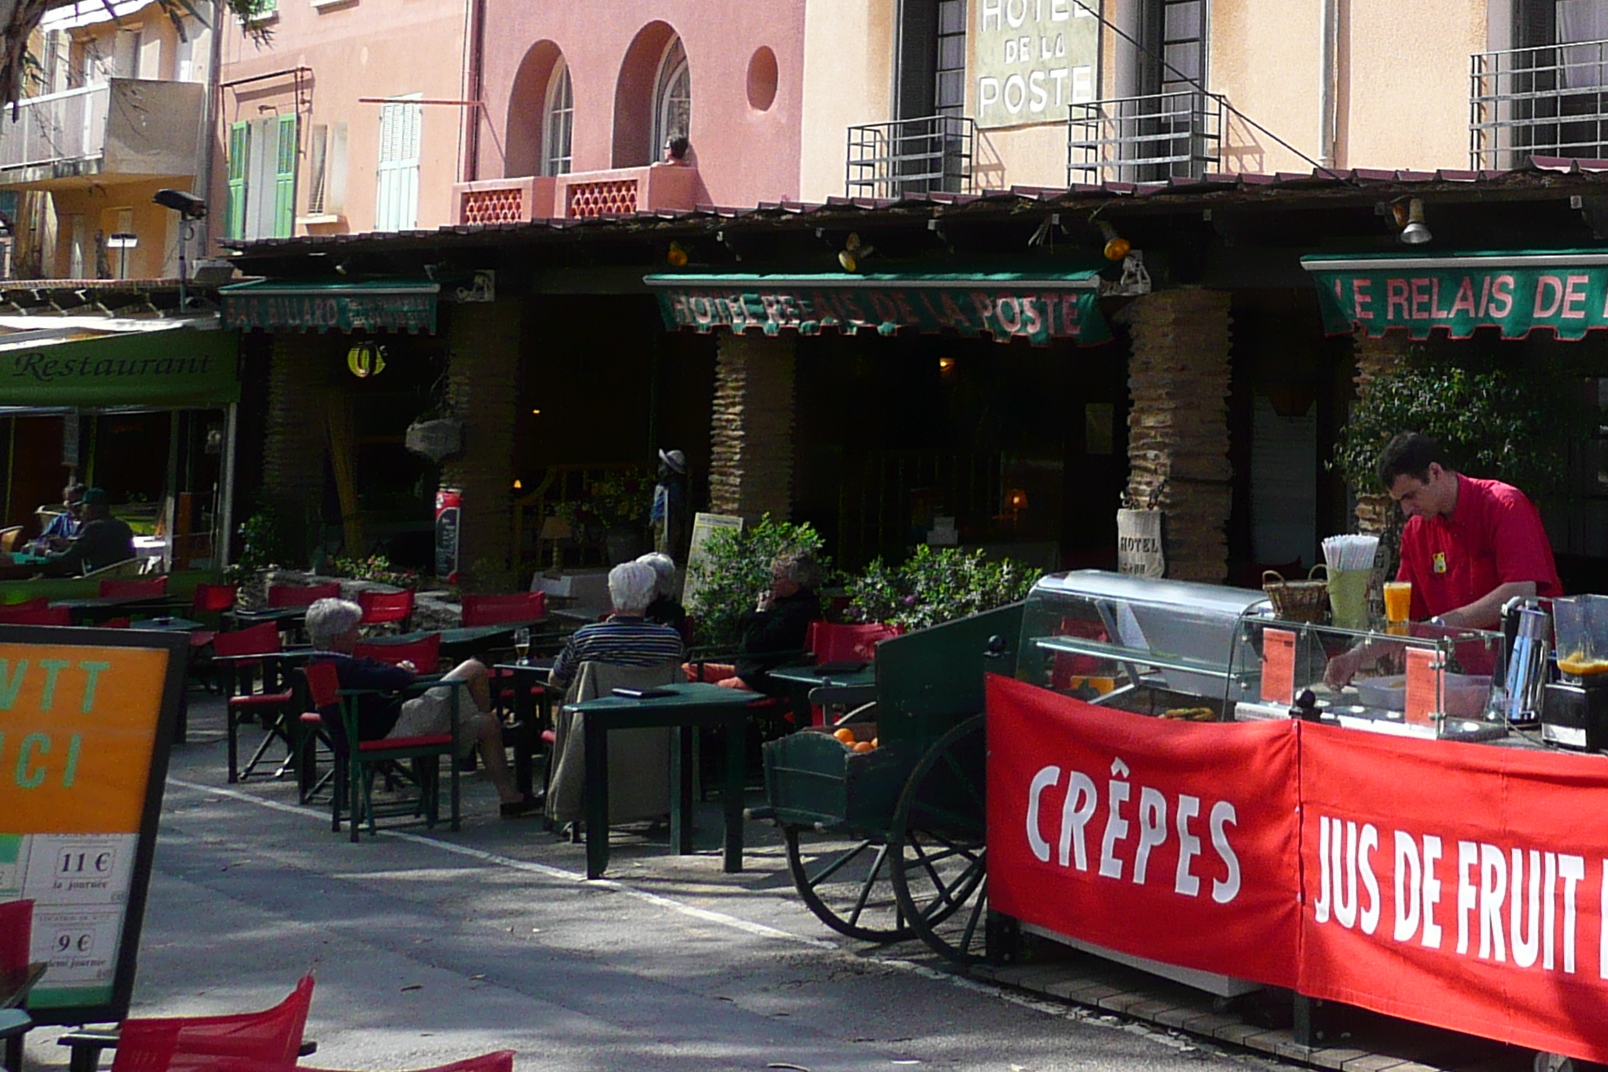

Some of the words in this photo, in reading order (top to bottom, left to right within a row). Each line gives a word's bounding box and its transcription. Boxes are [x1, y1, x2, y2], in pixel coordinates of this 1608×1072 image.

[1004, 35, 1031, 64] DE
[1040, 33, 1066, 60] LA
[978, 65, 1092, 118] POSTE
[970, 290, 1081, 334] POSTE
[1387, 275, 1515, 320] RELAIS
[1532, 275, 1589, 319] DE
[12, 352, 212, 383] Restaurant
[1120, 536, 1159, 553] HOTEL
[1025, 756, 1242, 904] CRÊPES
[61, 852, 86, 873] 11
[1313, 814, 1380, 936] JUS
[1393, 830, 1443, 950] DE
[1456, 839, 1586, 974] FRUIT
[57, 934, 71, 953] 9
